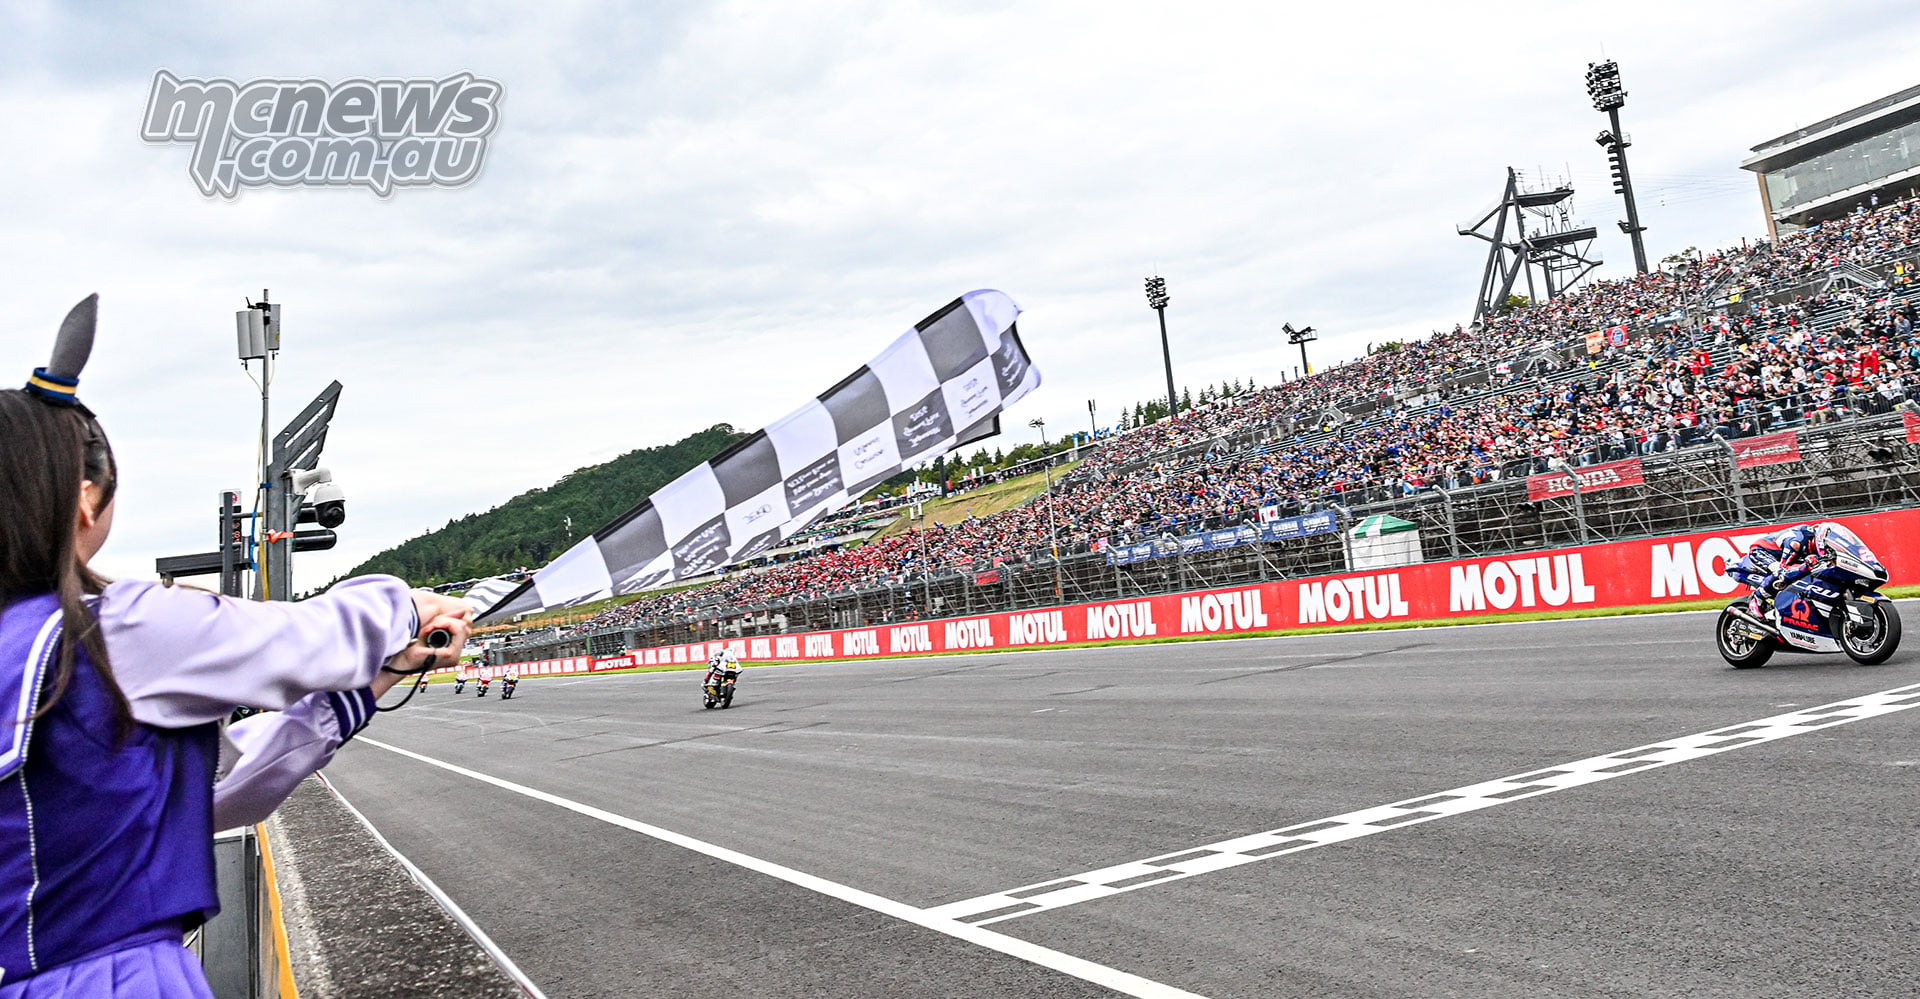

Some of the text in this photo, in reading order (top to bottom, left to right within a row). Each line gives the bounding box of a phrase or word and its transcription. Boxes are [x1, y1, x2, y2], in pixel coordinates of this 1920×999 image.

[1547, 469, 1622, 493] HONDA
[1794, 581, 1840, 599] CRU
[805, 634, 834, 657] MOTUL
[843, 630, 879, 656] MOTUL
[890, 625, 932, 653] MOTUL
[945, 618, 993, 649] MOTUL
[1010, 611, 1067, 644] MOTUL
[1087, 601, 1157, 639] MOTUL
[1181, 589, 1267, 632] MOTUL
[1299, 573, 1408, 624] MOTUL
[1450, 553, 1595, 612] MOTUL
[1783, 616, 1820, 631] PRAMAC
[594, 657, 633, 670] MOTUL
